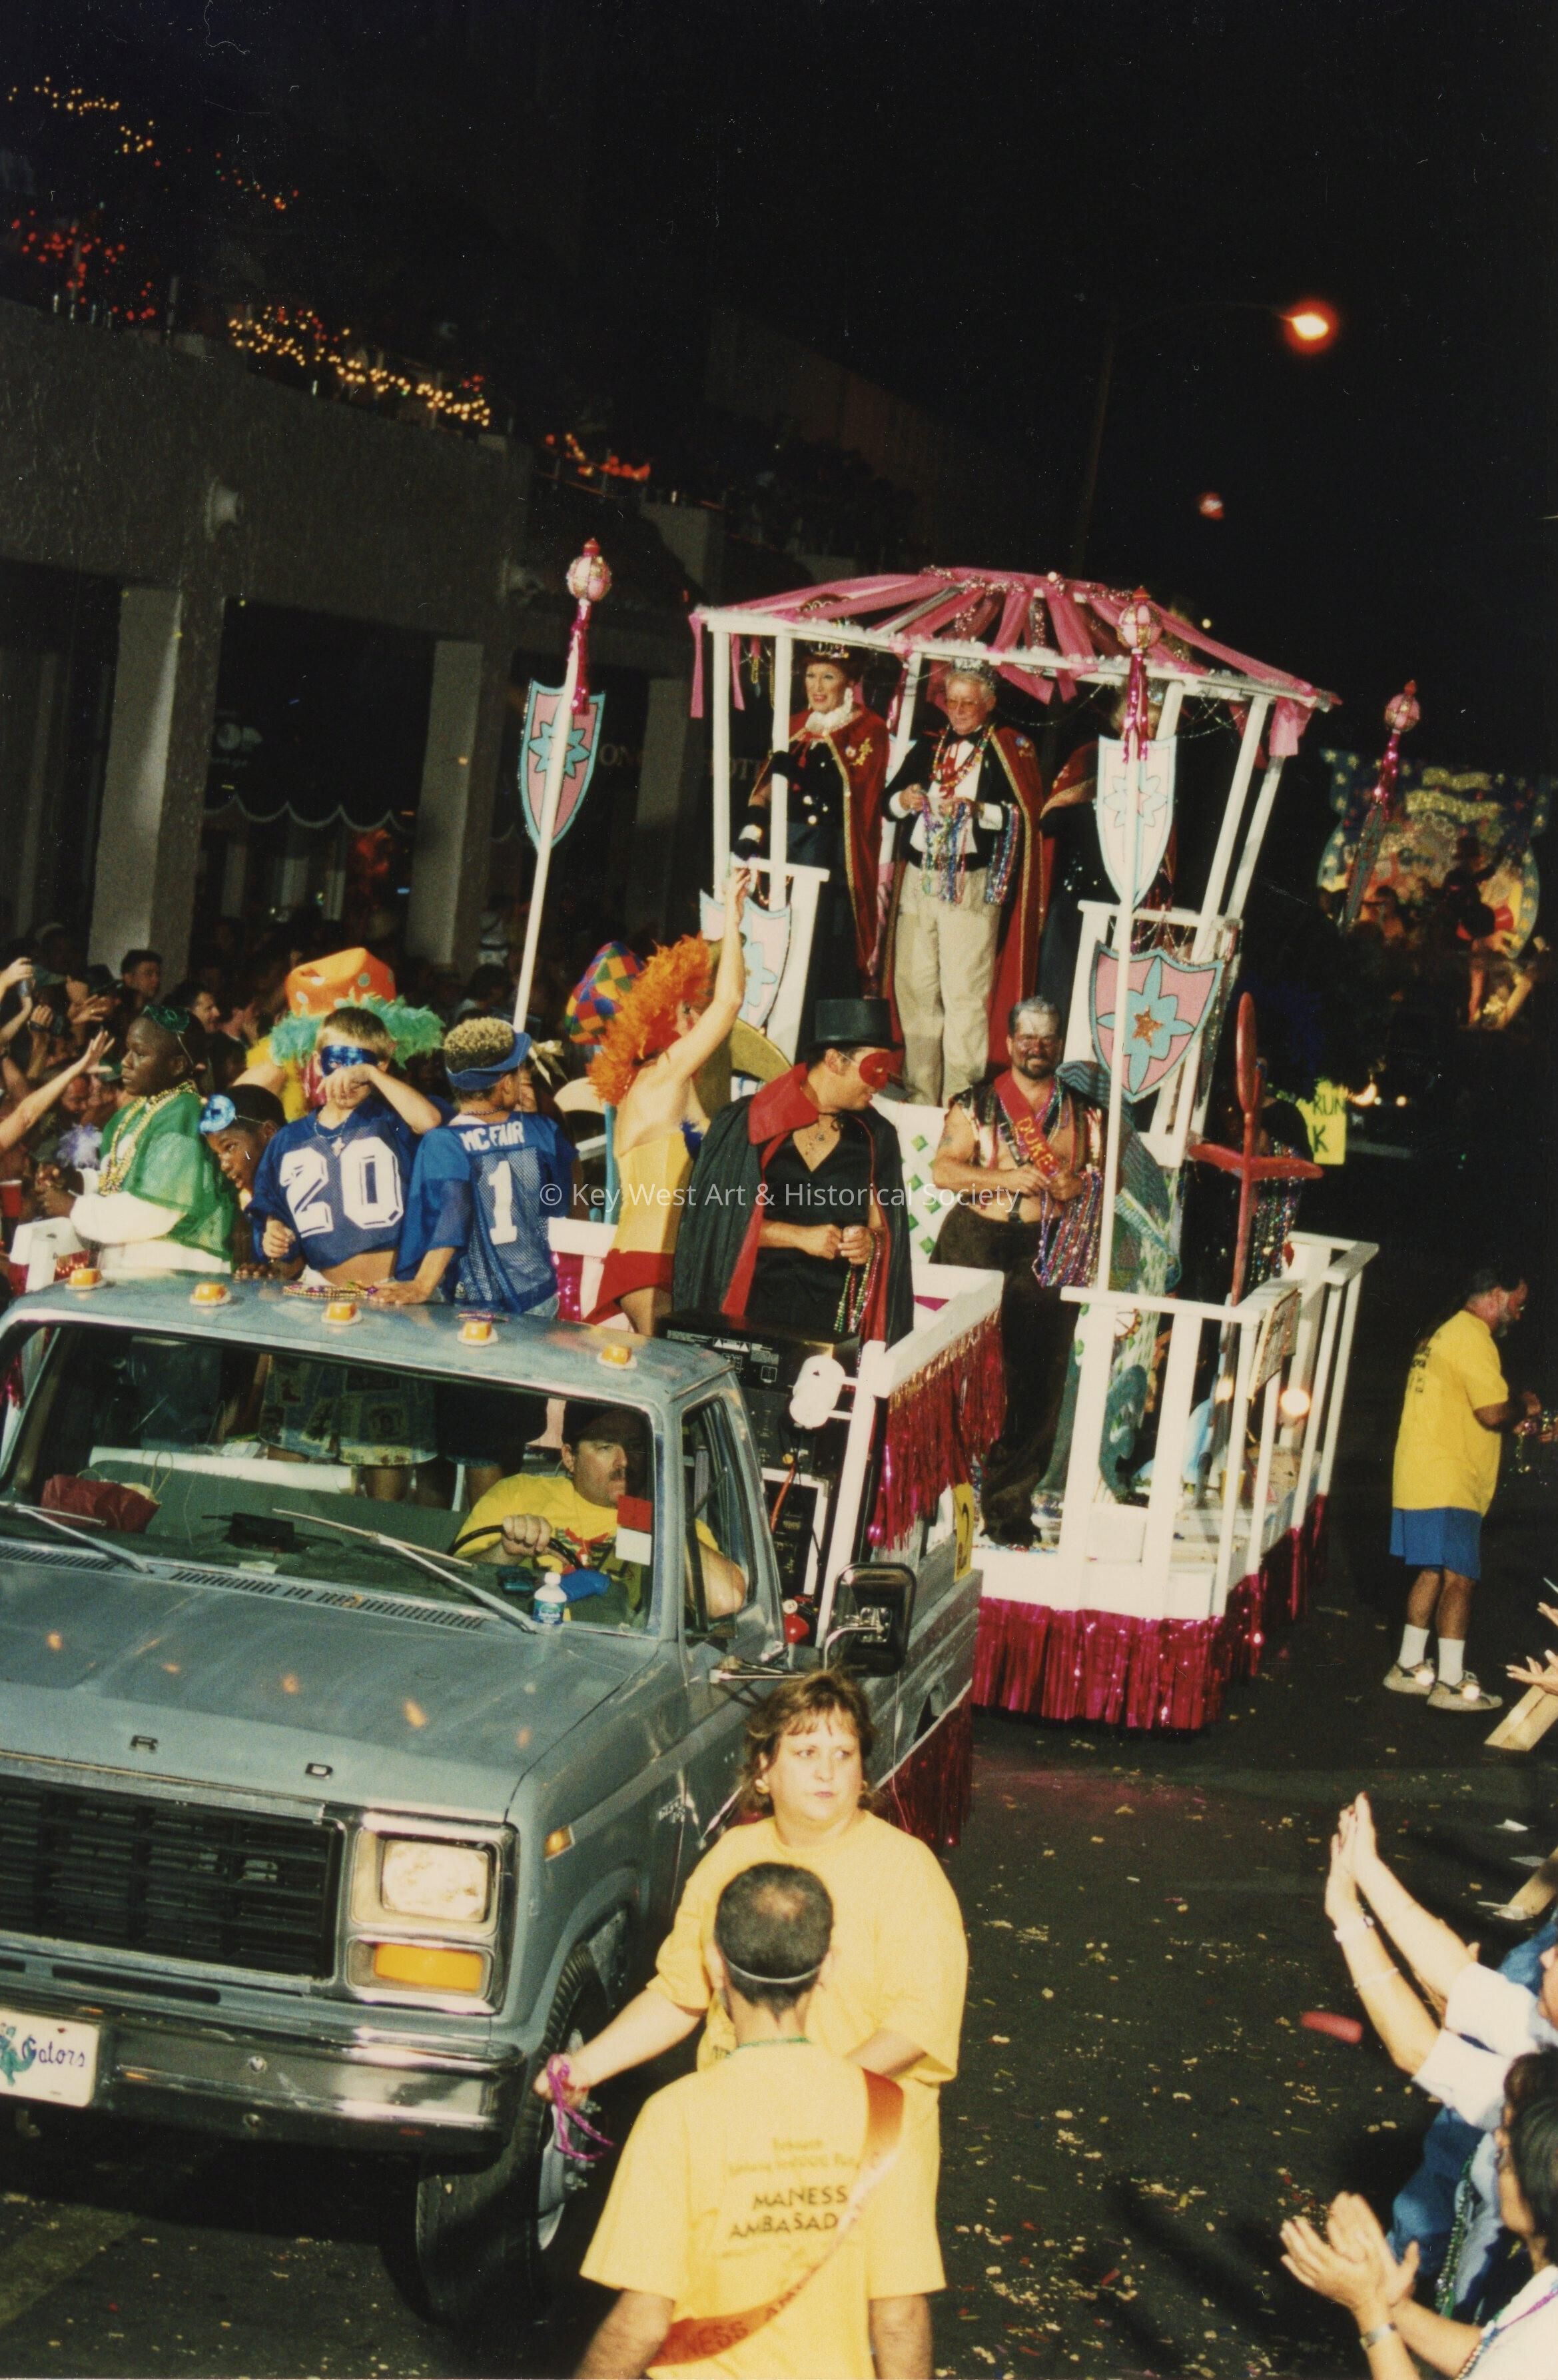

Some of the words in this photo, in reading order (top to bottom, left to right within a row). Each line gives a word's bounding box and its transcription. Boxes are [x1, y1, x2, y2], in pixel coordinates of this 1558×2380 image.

[279, 1137, 404, 1238] 20
[488, 1160, 518, 1245] 1
[22, 2035, 85, 2067] Gators
[753, 2185, 848, 2211] MANESS
